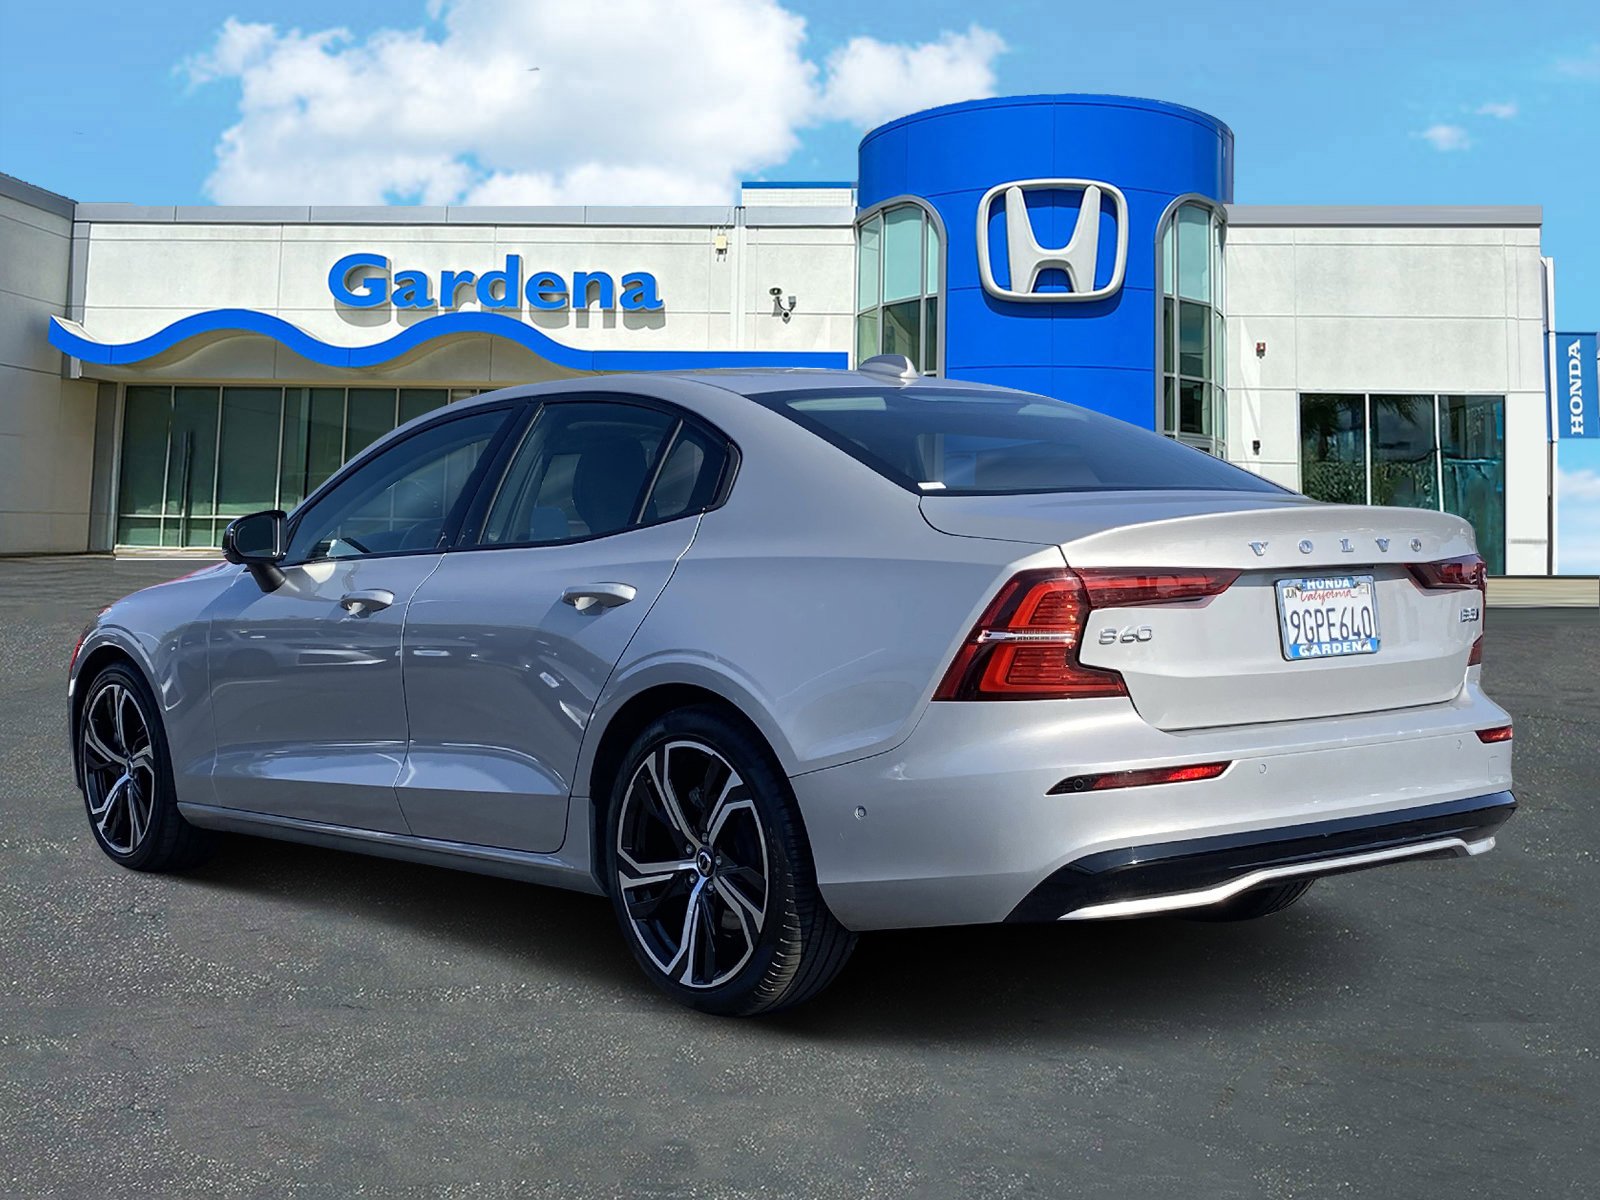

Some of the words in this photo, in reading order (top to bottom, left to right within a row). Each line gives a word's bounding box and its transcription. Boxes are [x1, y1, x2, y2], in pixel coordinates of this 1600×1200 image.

[328, 253, 664, 309] Gardena
[1568, 339, 1584, 435] HONDA
[1248, 537, 1422, 557] VOLVO
[1306, 578, 1351, 590] HONDA
[1300, 589, 1358, 606] California
[1098, 625, 1152, 645] S60
[1290, 605, 1372, 645] 9GPE640
[1298, 640, 1373, 657] GARDENA
